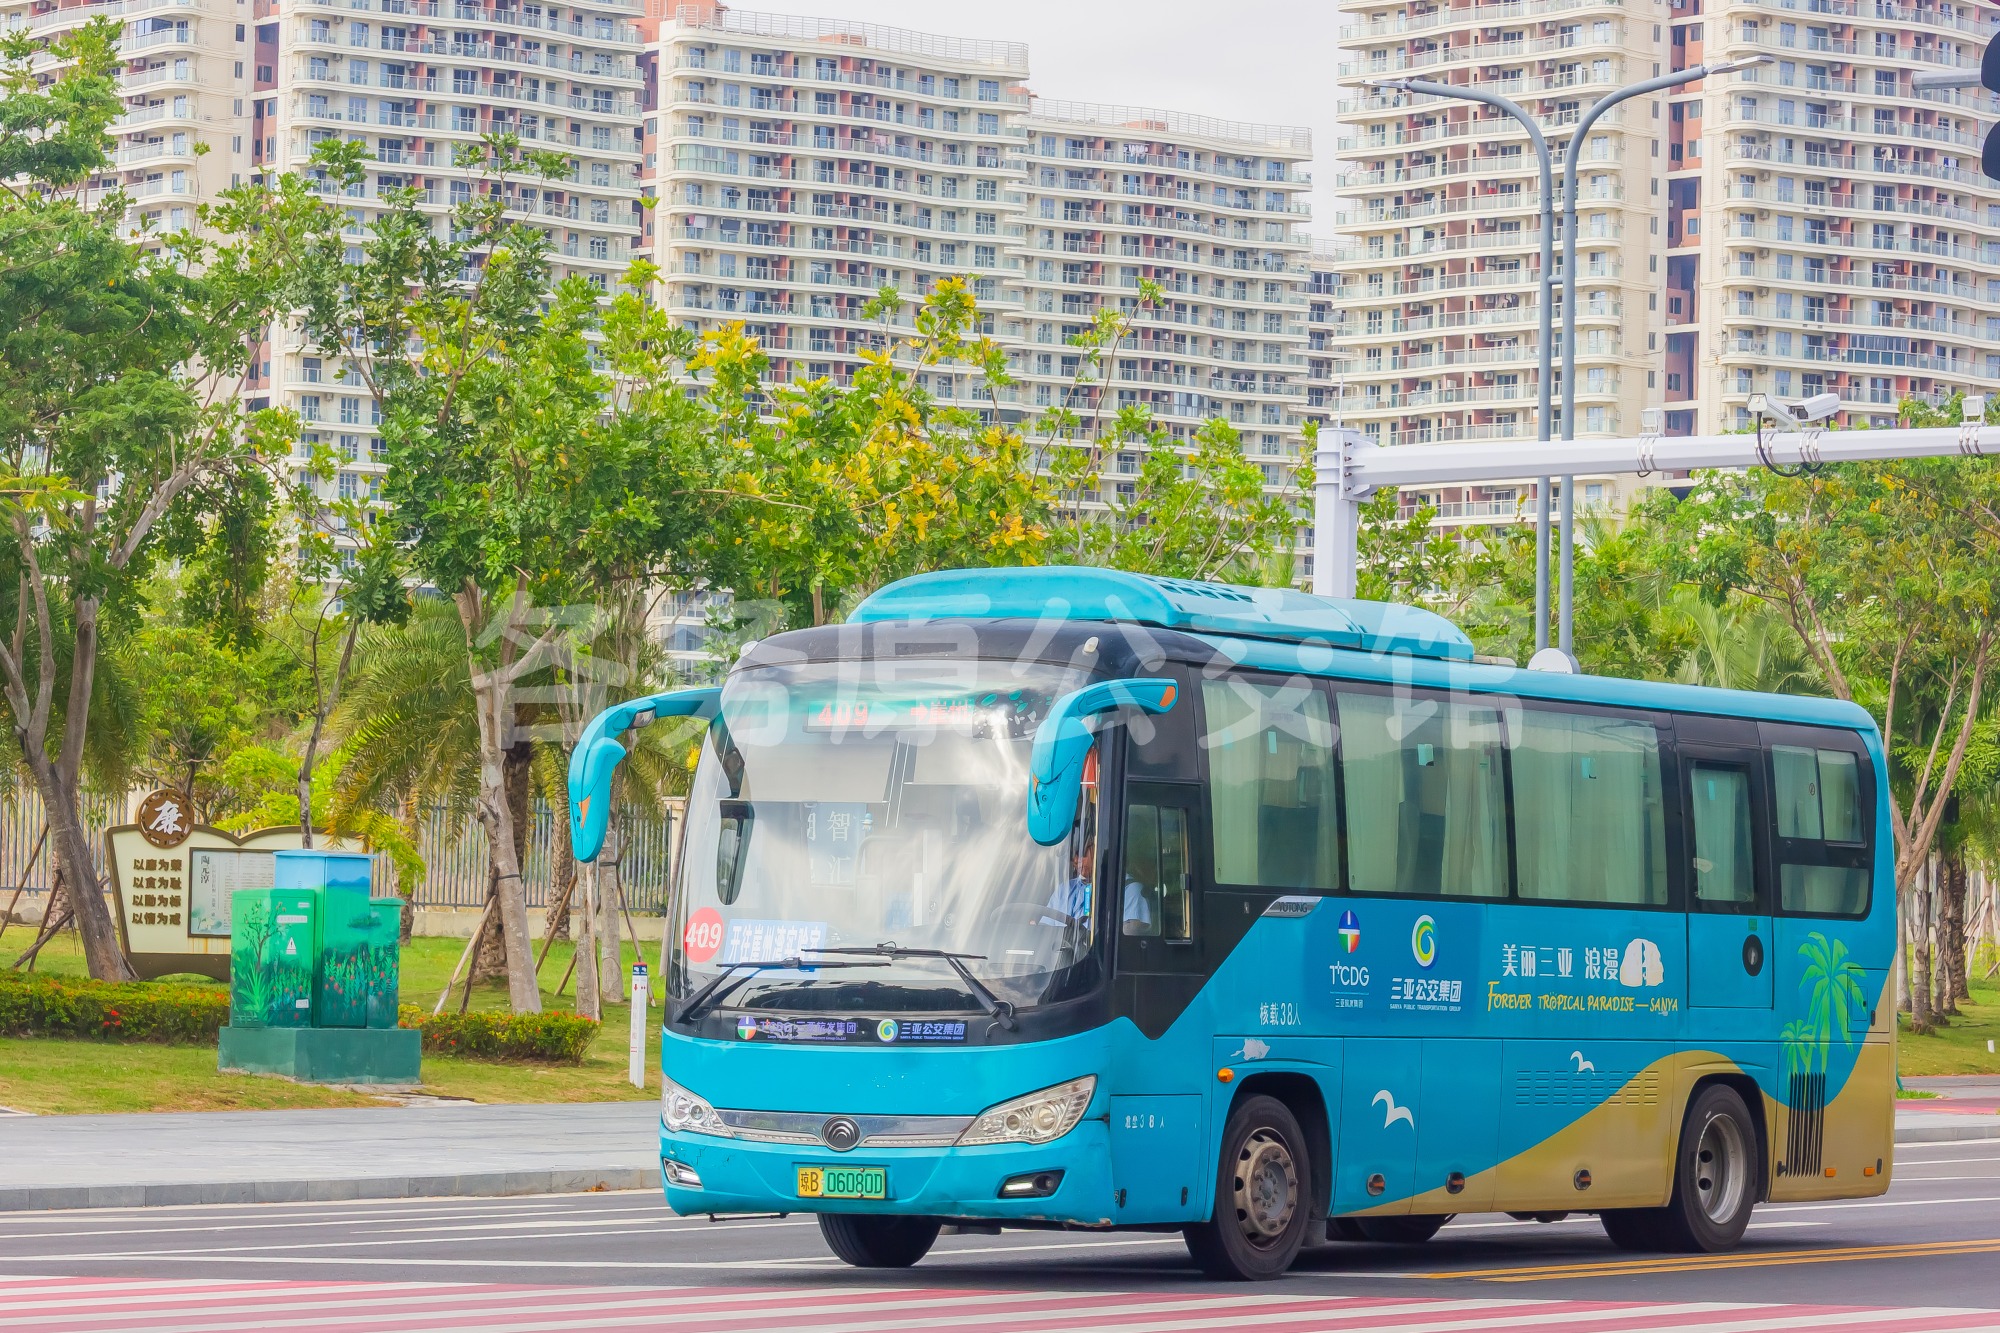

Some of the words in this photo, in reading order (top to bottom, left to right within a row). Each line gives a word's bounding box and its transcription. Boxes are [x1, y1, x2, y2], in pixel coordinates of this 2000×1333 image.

[818, 701, 869, 726] 409
[1278, 902, 1308, 913] YUTONG
[685, 922, 722, 949] 409
[1502, 943, 1573, 978] 美丽三亚
[1584, 947, 1619, 981] 浪漫
[1391, 977, 1462, 1003] 三亚公交集团
[1260, 1002, 1302, 1026] 核载38人
[901, 1022, 965, 1035] 三亚公交集团
